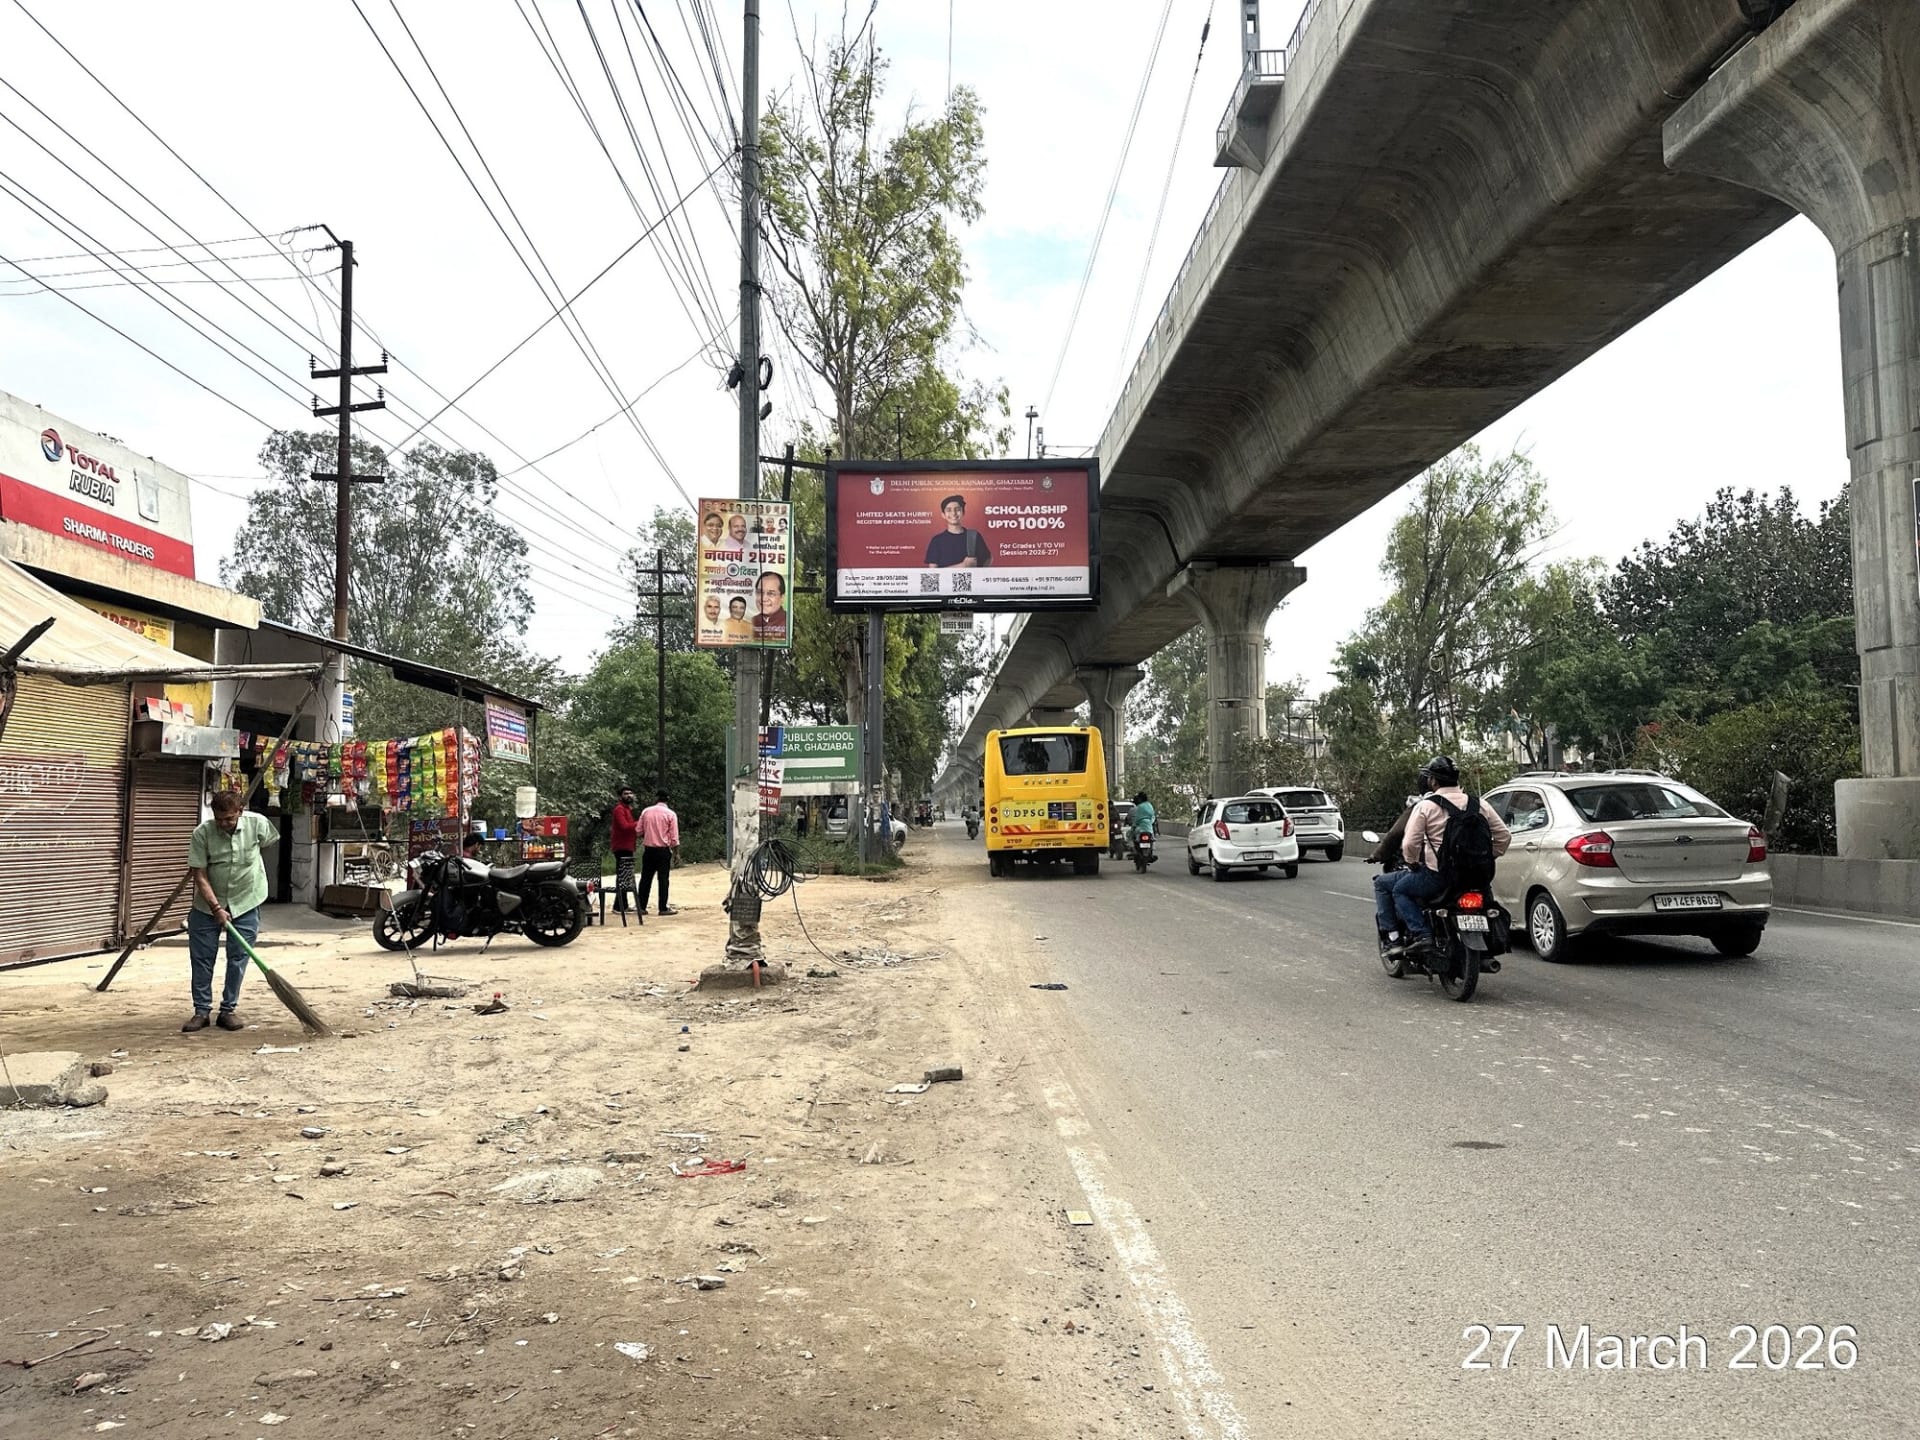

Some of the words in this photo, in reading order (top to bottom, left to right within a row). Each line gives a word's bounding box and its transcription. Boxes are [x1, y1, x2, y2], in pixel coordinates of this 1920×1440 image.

[65, 443, 120, 484] TOTAL
[69, 469, 115, 507] RUBIA
[984, 504, 1068, 515] SCHOLARSHIP
[987, 519, 1018, 529] UPTO
[1018, 517, 1066, 530] 100%
[63, 517, 110, 546] SHARMA
[108, 533, 155, 560] TRADERS
[704, 548, 744, 562] नववर्ष
[749, 552, 785, 564] 2026
[1000, 549, 1028, 557] (Session
[783, 732, 815, 742] PUBLIC
[816, 731, 855, 741] SCHOOL
[804, 742, 854, 752] GHAZIABAD
[1013, 808, 1045, 818] DPSG
[1661, 895, 1719, 907] UP14EF8603
